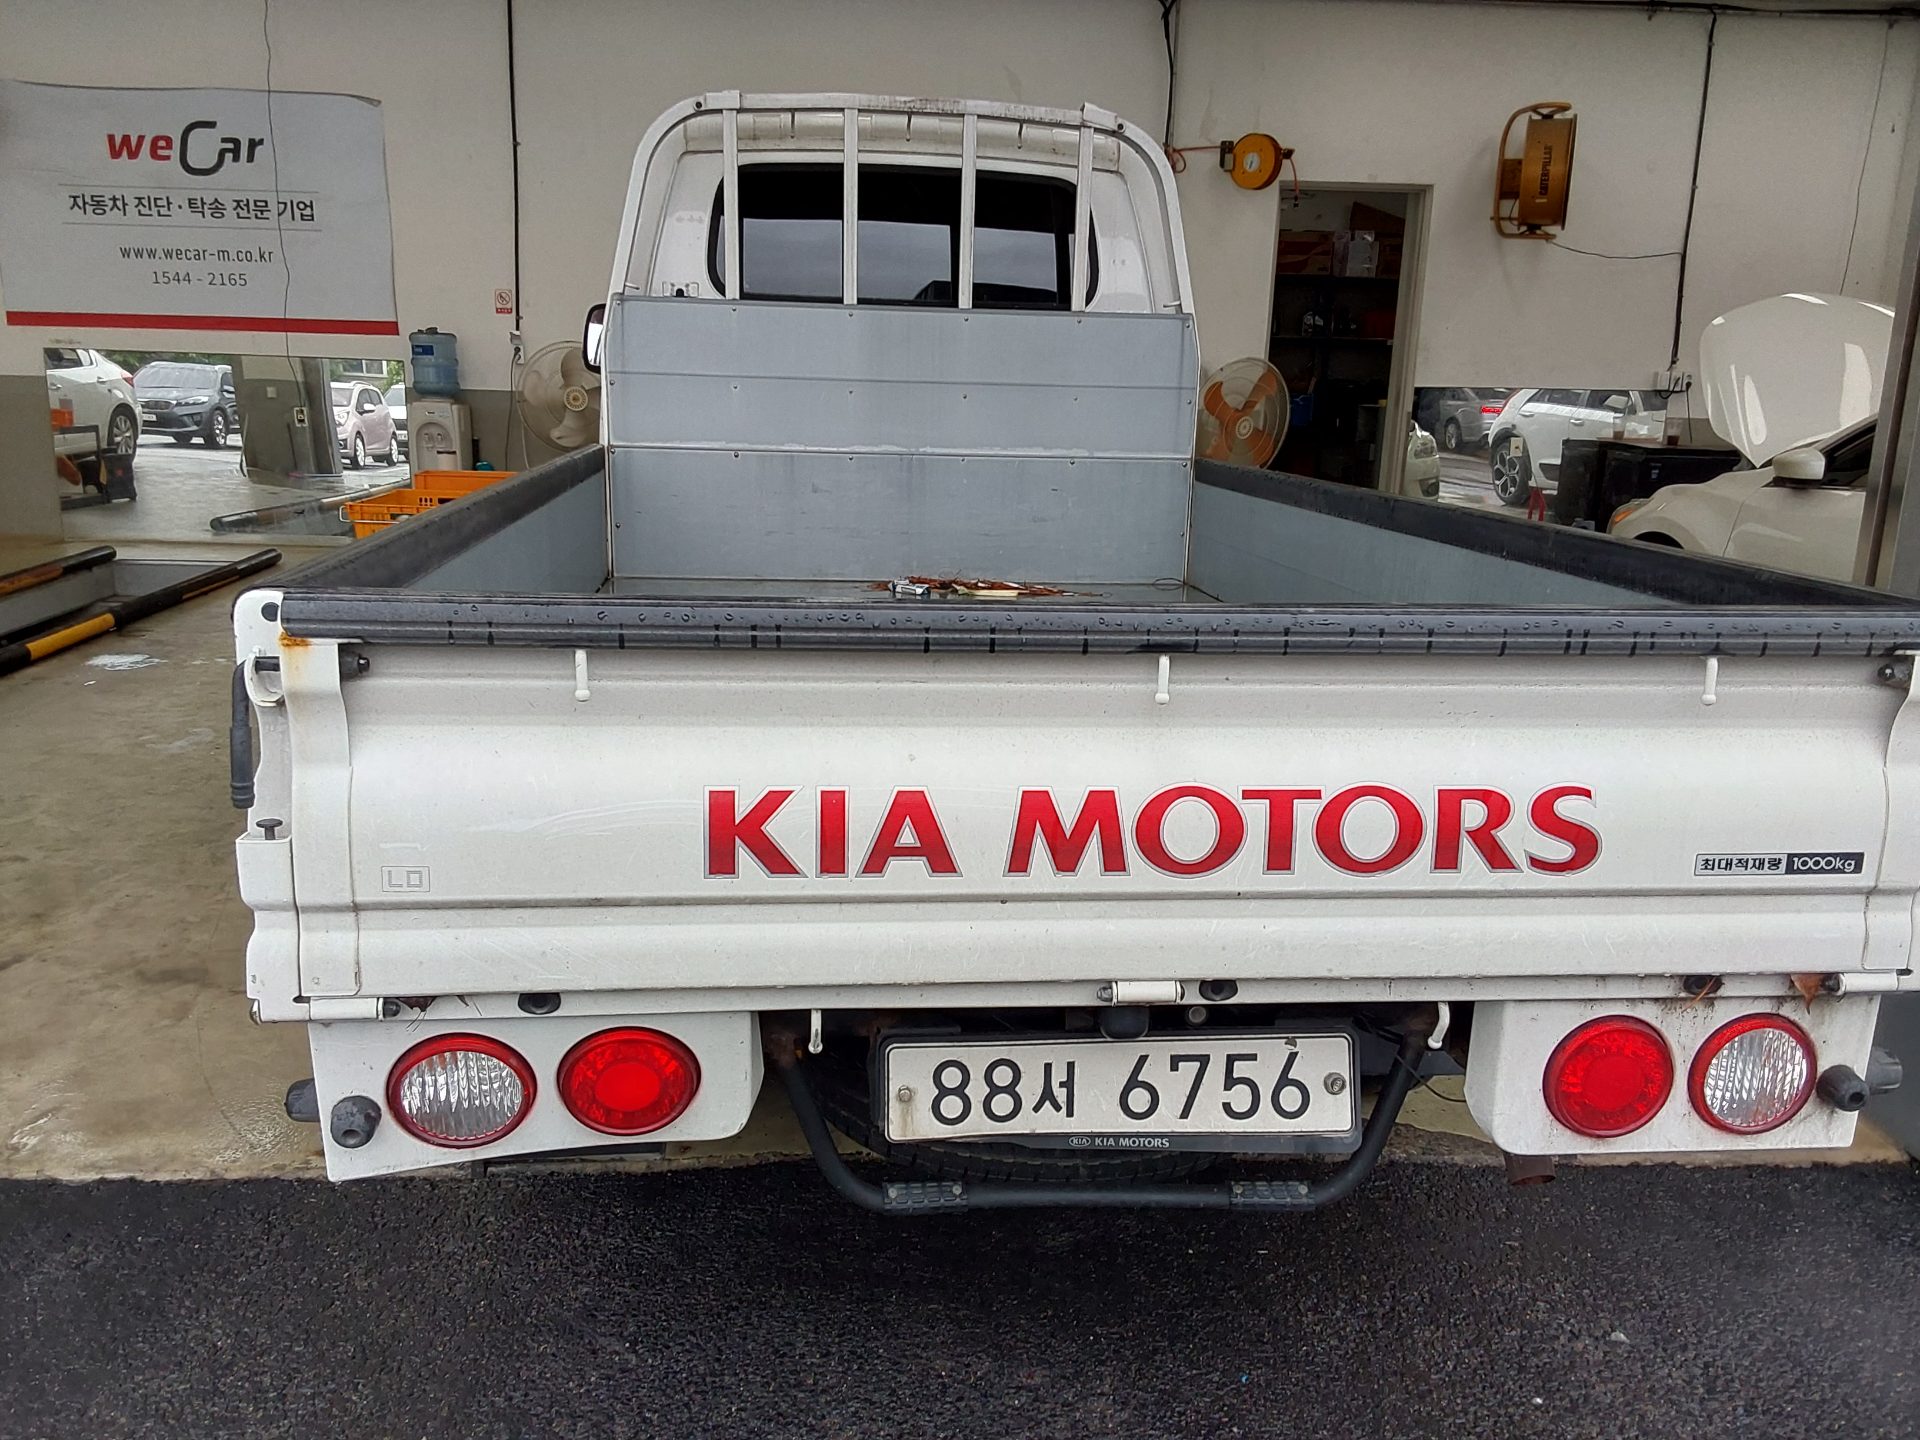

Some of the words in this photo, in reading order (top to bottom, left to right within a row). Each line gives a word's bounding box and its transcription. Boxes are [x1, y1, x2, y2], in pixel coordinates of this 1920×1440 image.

[107, 120, 265, 176] weCar
[1538, 144, 1553, 196] CATERPILLAR
[68, 193, 128, 217] 자동차
[232, 198, 271, 221] 전문
[277, 199, 315, 222] 기업
[120, 244, 274, 264] www.wecar-m.co.kr
[704, 786, 963, 879] KIA
[1003, 781, 1603, 879] MOTORS
[1699, 857, 1783, 871] 최대적재량
[1792, 856, 1856, 872] 1000kg
[931, 1057, 1075, 1127] 88서
[1119, 1050, 1312, 1121] 6756
[1071, 1137, 1089, 1146] KIA
[1095, 1137, 1116, 1147] KIA
[1118, 1137, 1170, 1148] MOTORS
